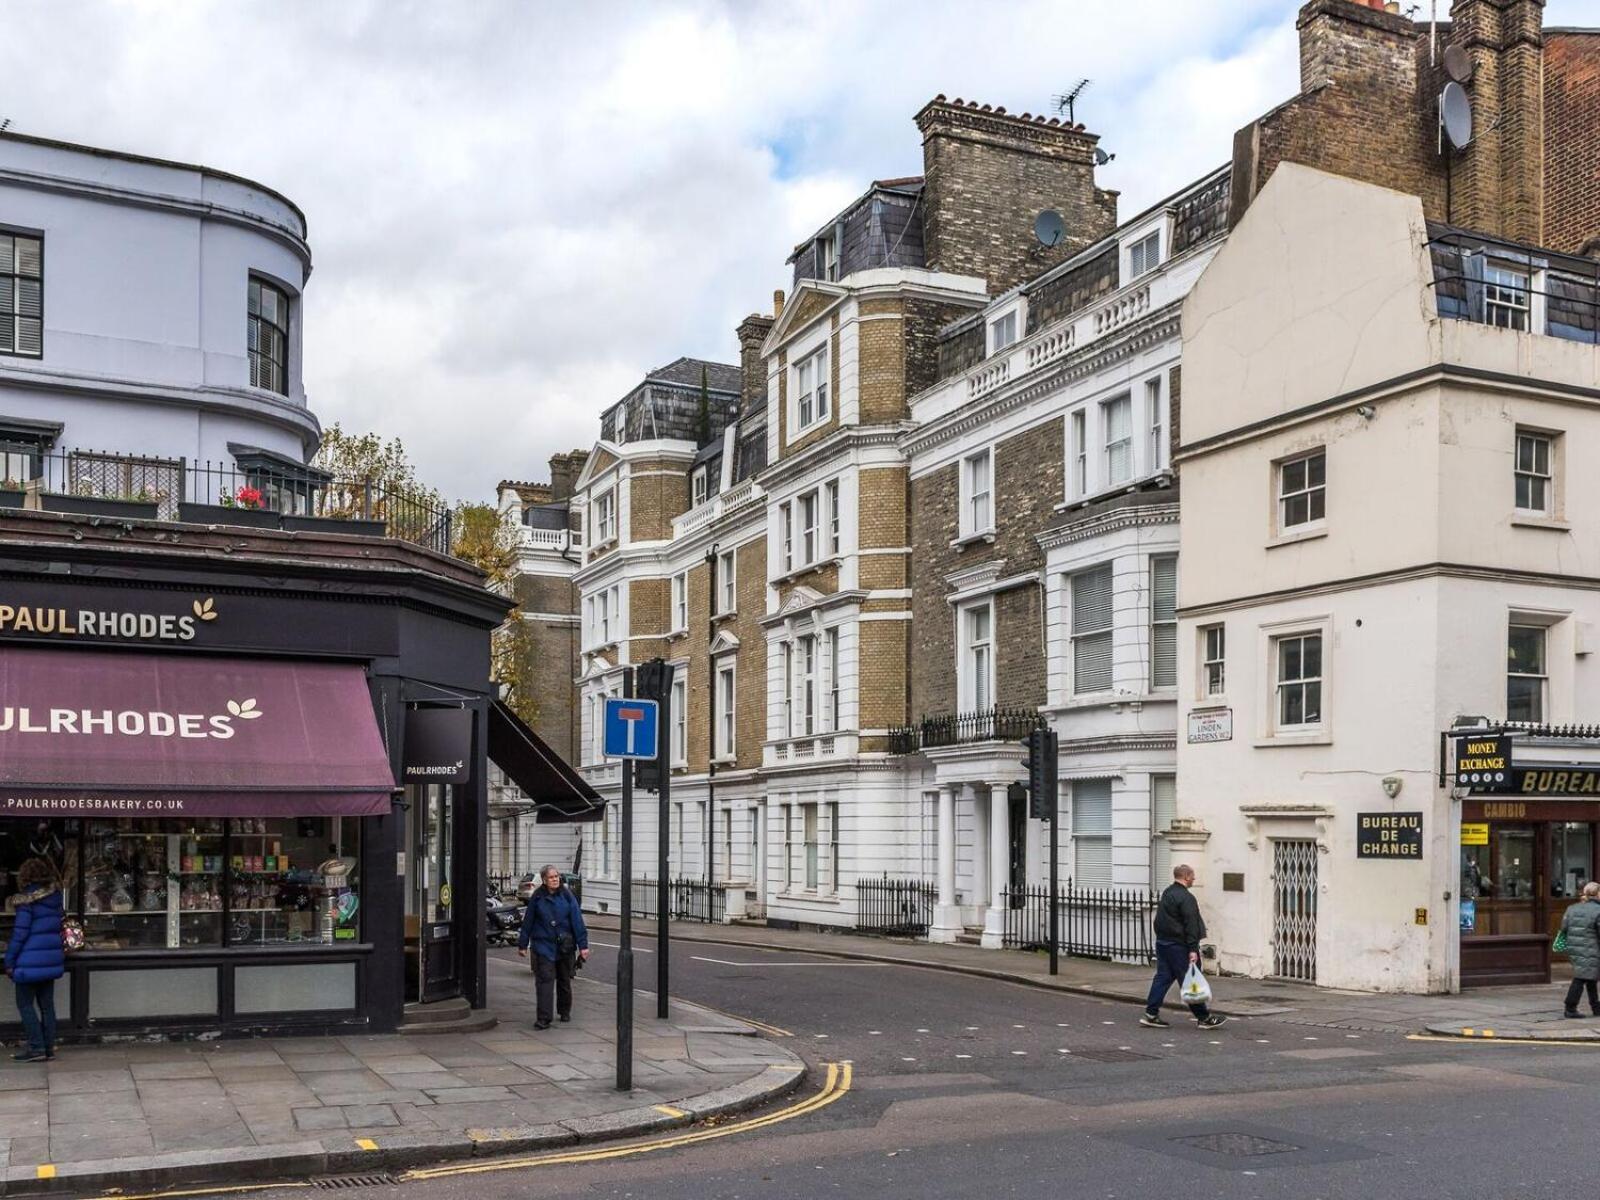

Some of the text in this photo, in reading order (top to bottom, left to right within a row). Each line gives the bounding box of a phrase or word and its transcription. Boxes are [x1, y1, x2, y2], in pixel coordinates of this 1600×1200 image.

[0, 605, 196, 640] PAULRHODES
[1467, 742, 1498, 754] MONEY
[1460, 757, 1505, 770] EXCHANGE
[406, 766, 458, 775] PAULRHODES
[1522, 771, 1600, 793] BUREA
[1484, 802, 1526, 818] CAMBIO
[1362, 817, 1418, 828] BUREAU
[1381, 830, 1399, 841] DE
[1362, 843, 1418, 855] CHANGE
